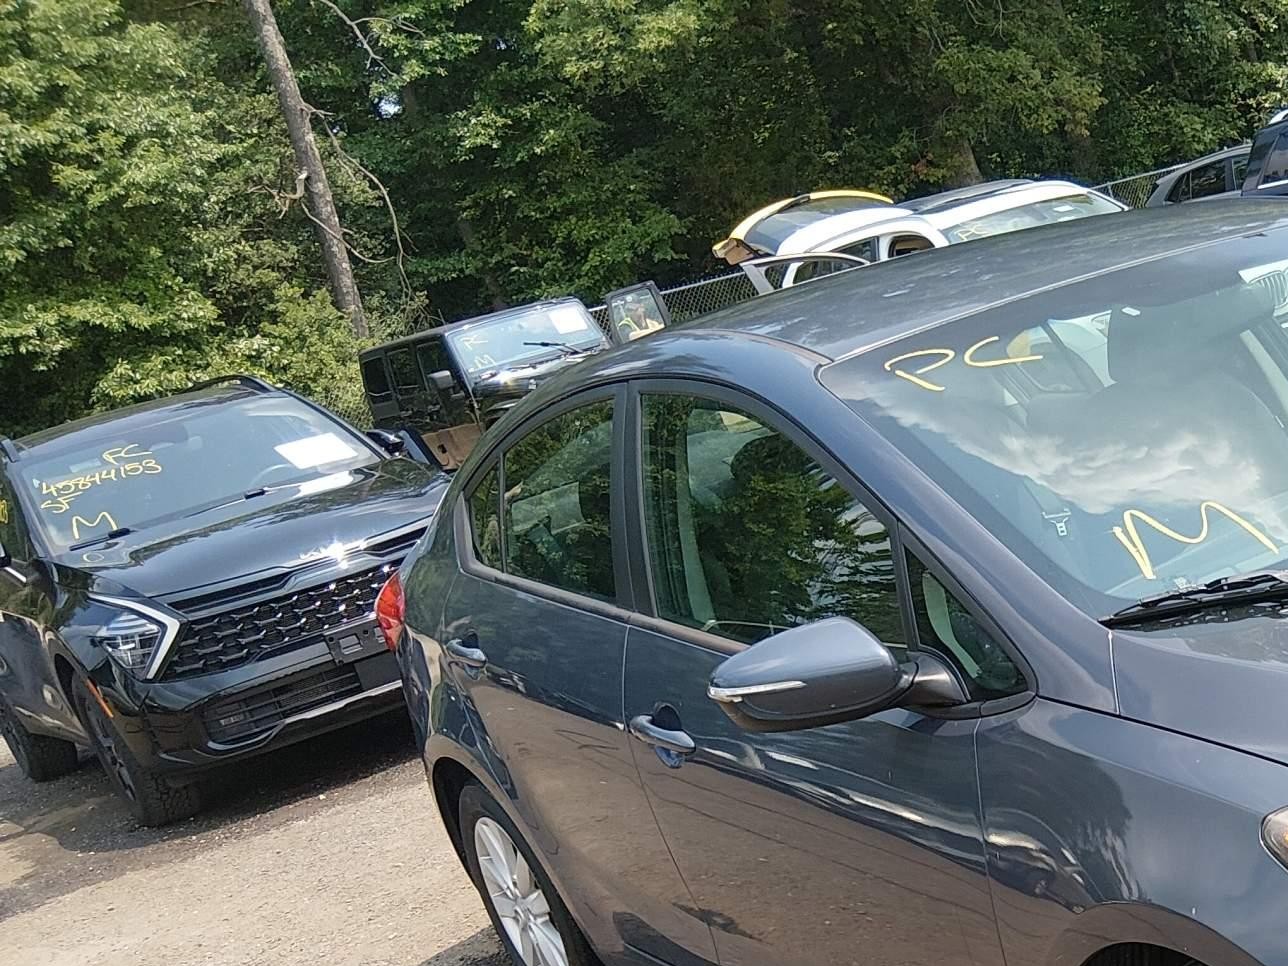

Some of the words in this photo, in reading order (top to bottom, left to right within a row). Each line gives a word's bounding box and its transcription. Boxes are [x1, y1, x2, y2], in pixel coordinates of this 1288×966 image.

[42, 459, 163, 496] 45844153
[71, 511, 118, 540] M
[1111, 501, 1280, 581] M
